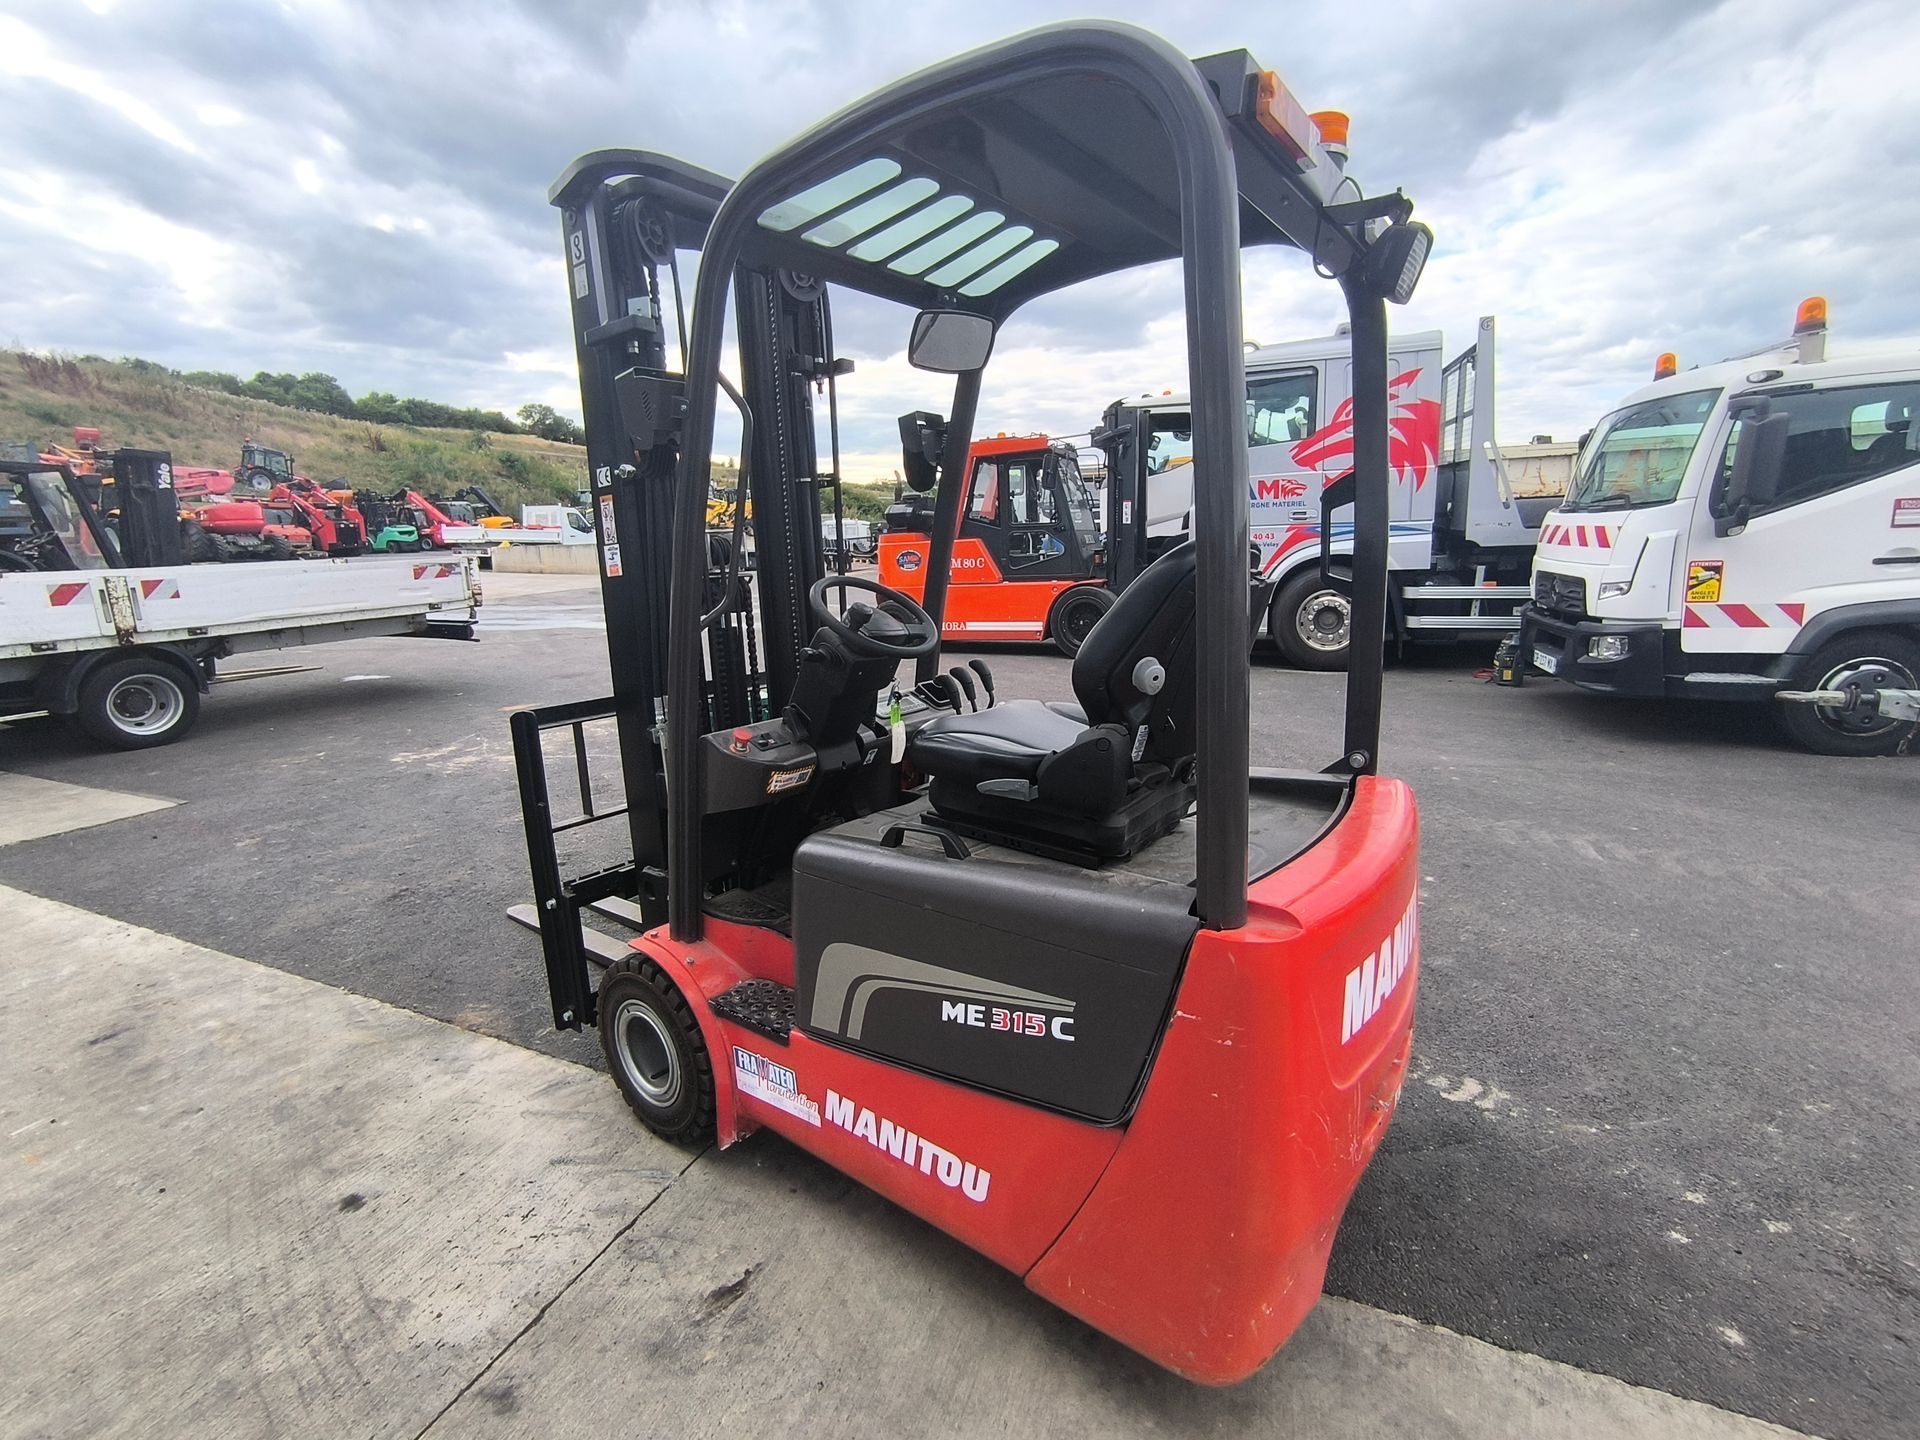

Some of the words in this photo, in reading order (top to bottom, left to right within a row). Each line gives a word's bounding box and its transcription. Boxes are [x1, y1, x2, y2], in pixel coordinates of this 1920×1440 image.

[157, 463, 171, 489] Yale
[963, 558, 975, 568] 80
[977, 558, 985, 568] C
[942, 1000, 986, 1028] ME
[990, 1007, 1046, 1037] 315
[1051, 1016, 1075, 1041] C
[825, 1088, 991, 1203] MANITOU
